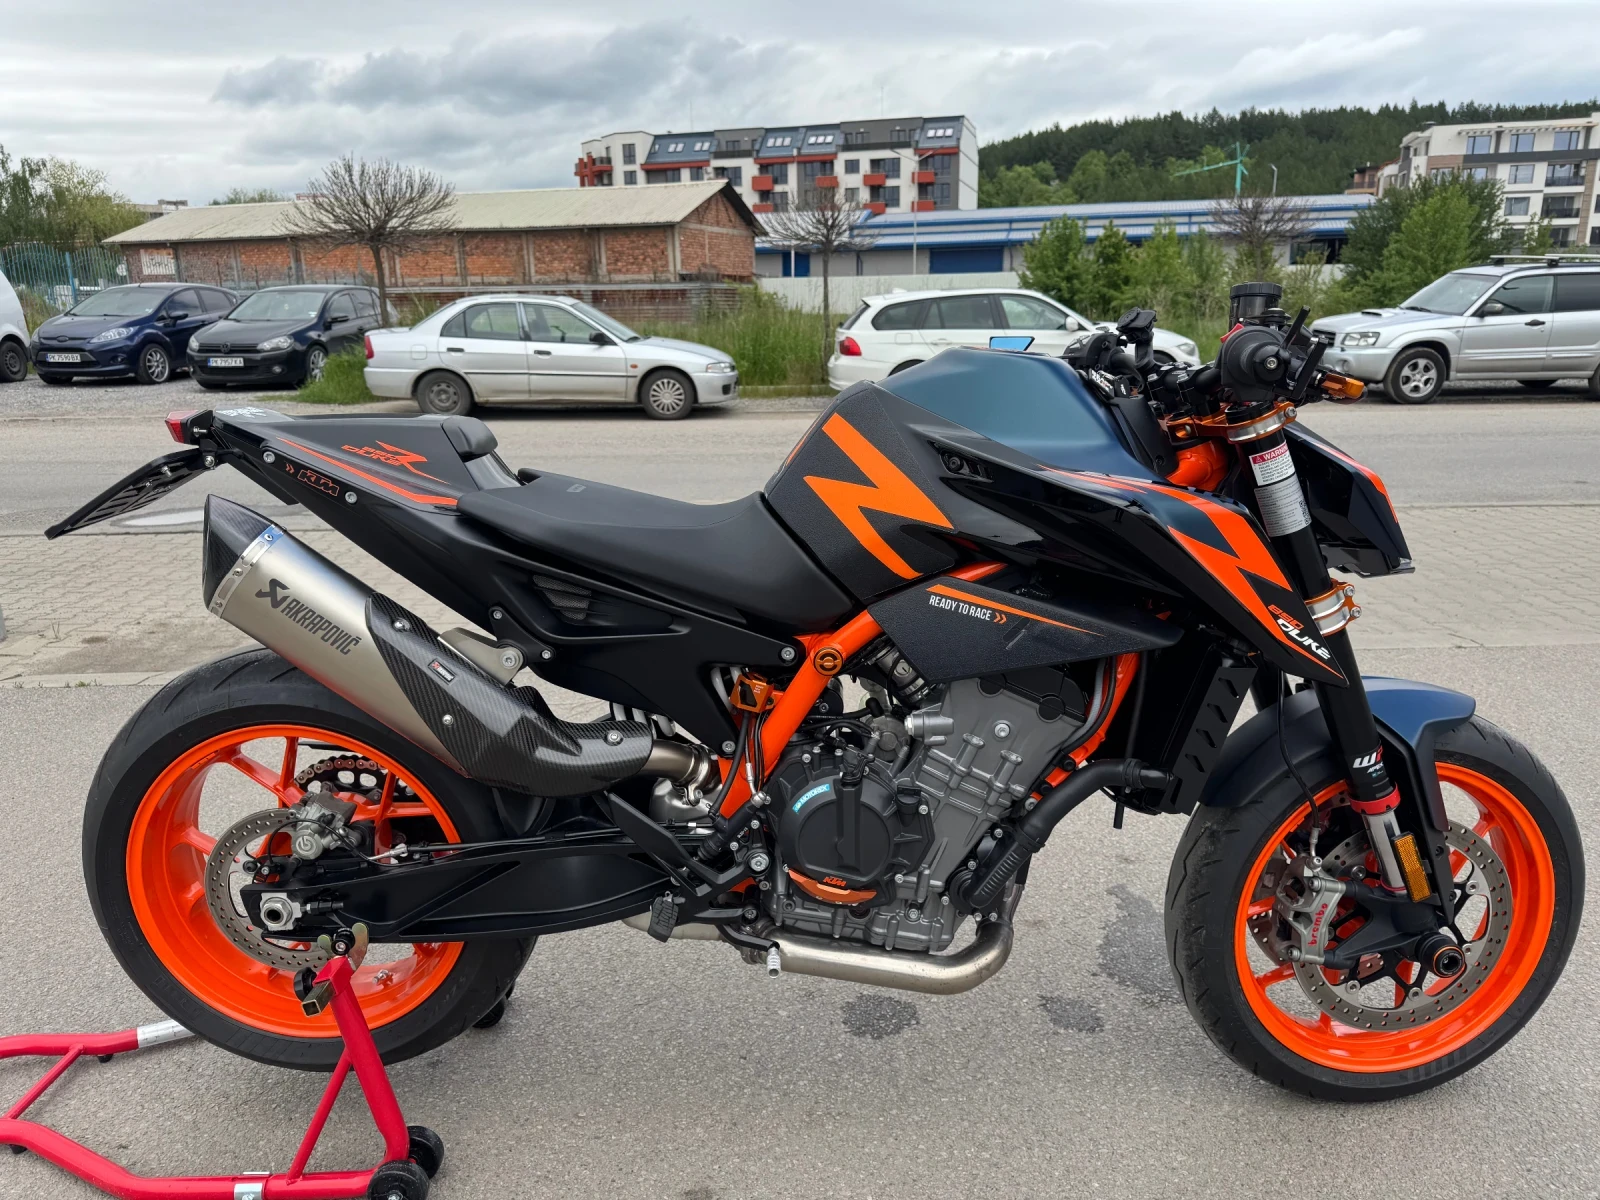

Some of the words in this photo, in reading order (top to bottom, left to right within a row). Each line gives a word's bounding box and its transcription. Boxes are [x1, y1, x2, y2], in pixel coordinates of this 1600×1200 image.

[297, 469, 339, 497] KTM
[929, 595, 957, 611] READY
[958, 602, 969, 614] TO
[969, 606, 992, 620] RACE
[1276, 618, 1331, 659] DUKE
[1308, 903, 1328, 946] brembo
